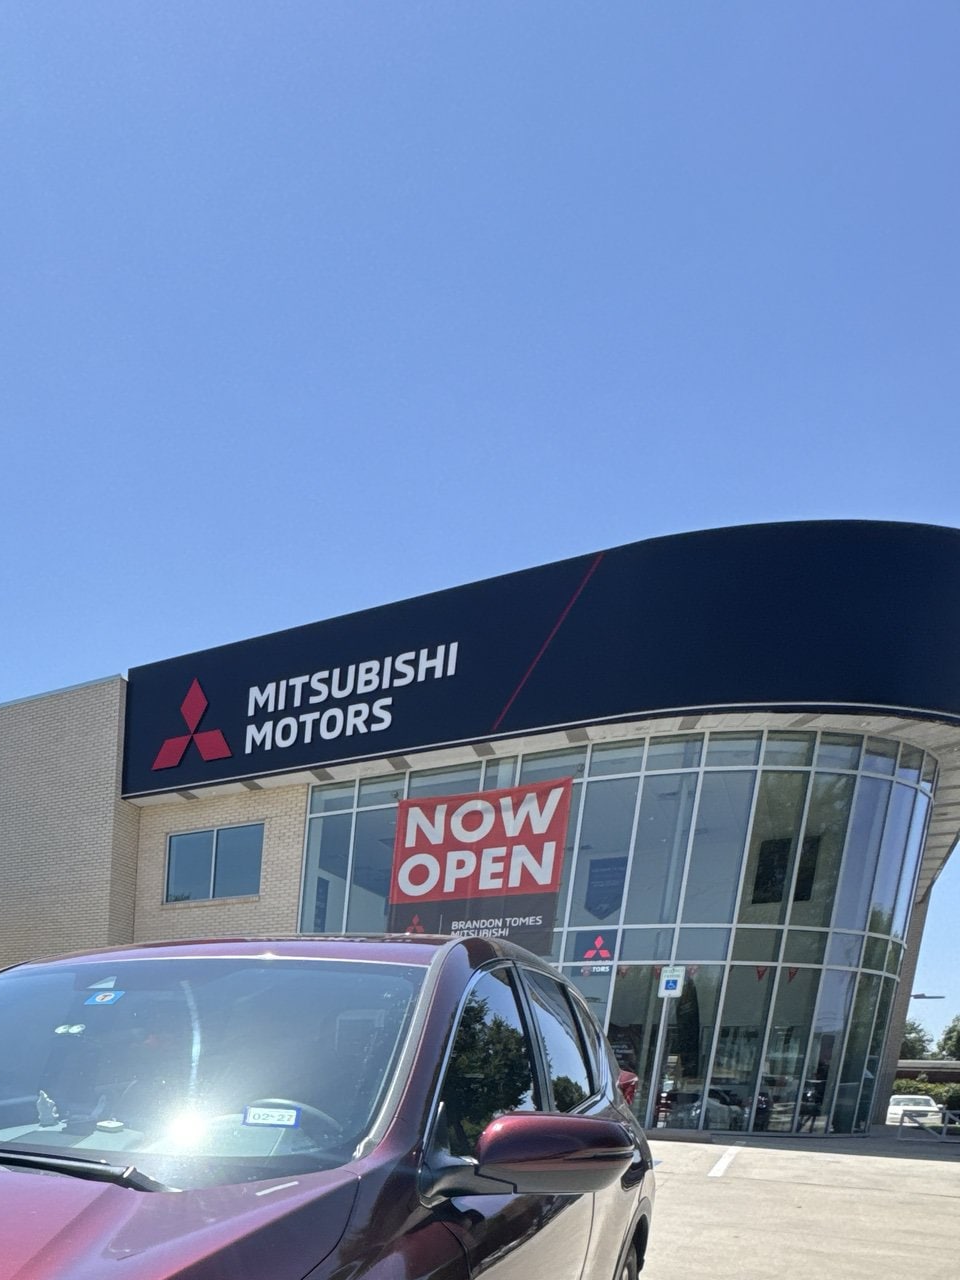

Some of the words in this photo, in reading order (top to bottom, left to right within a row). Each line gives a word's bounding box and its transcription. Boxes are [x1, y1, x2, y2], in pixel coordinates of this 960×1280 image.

[247, 642, 459, 717] MITSUBISHI
[244, 697, 393, 754] MOTORS
[405, 787, 565, 848] NOW
[397, 841, 557, 897] OPEN
[451, 918, 503, 931] BRANDON
[505, 915, 543, 927] TOMES
